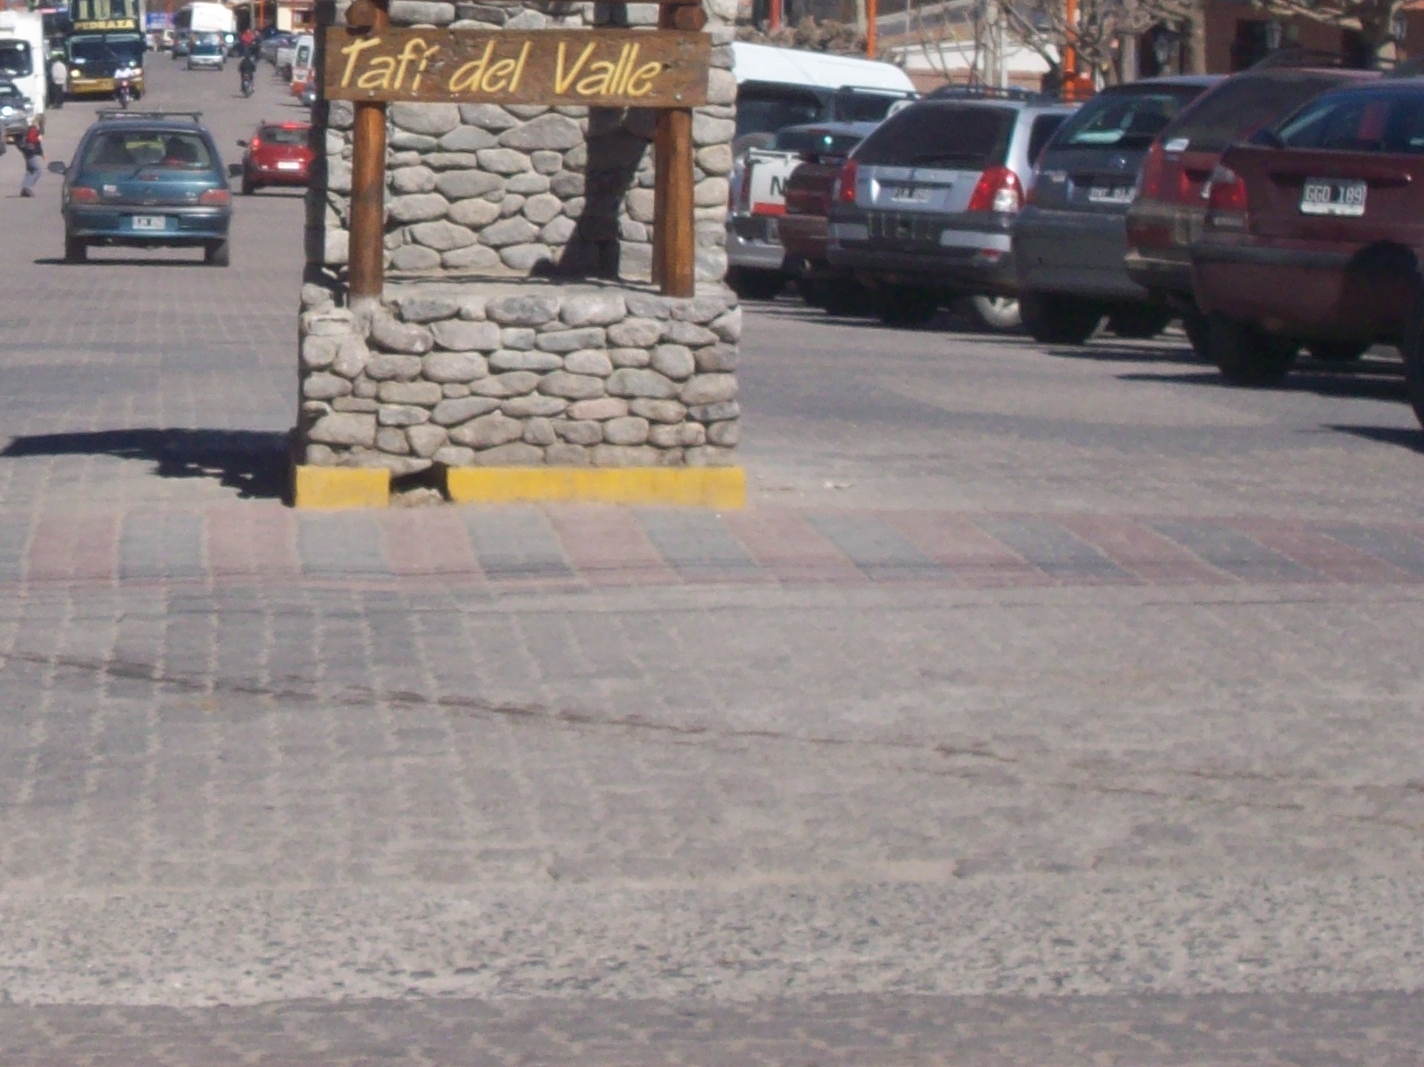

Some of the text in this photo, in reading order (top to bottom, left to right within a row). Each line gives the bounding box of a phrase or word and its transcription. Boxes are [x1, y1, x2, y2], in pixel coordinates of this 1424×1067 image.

[73, 19, 136, 30] PEDRAZA
[448, 39, 533, 93] del
[554, 41, 662, 97] Valle
[1339, 186, 1363, 204] 189
